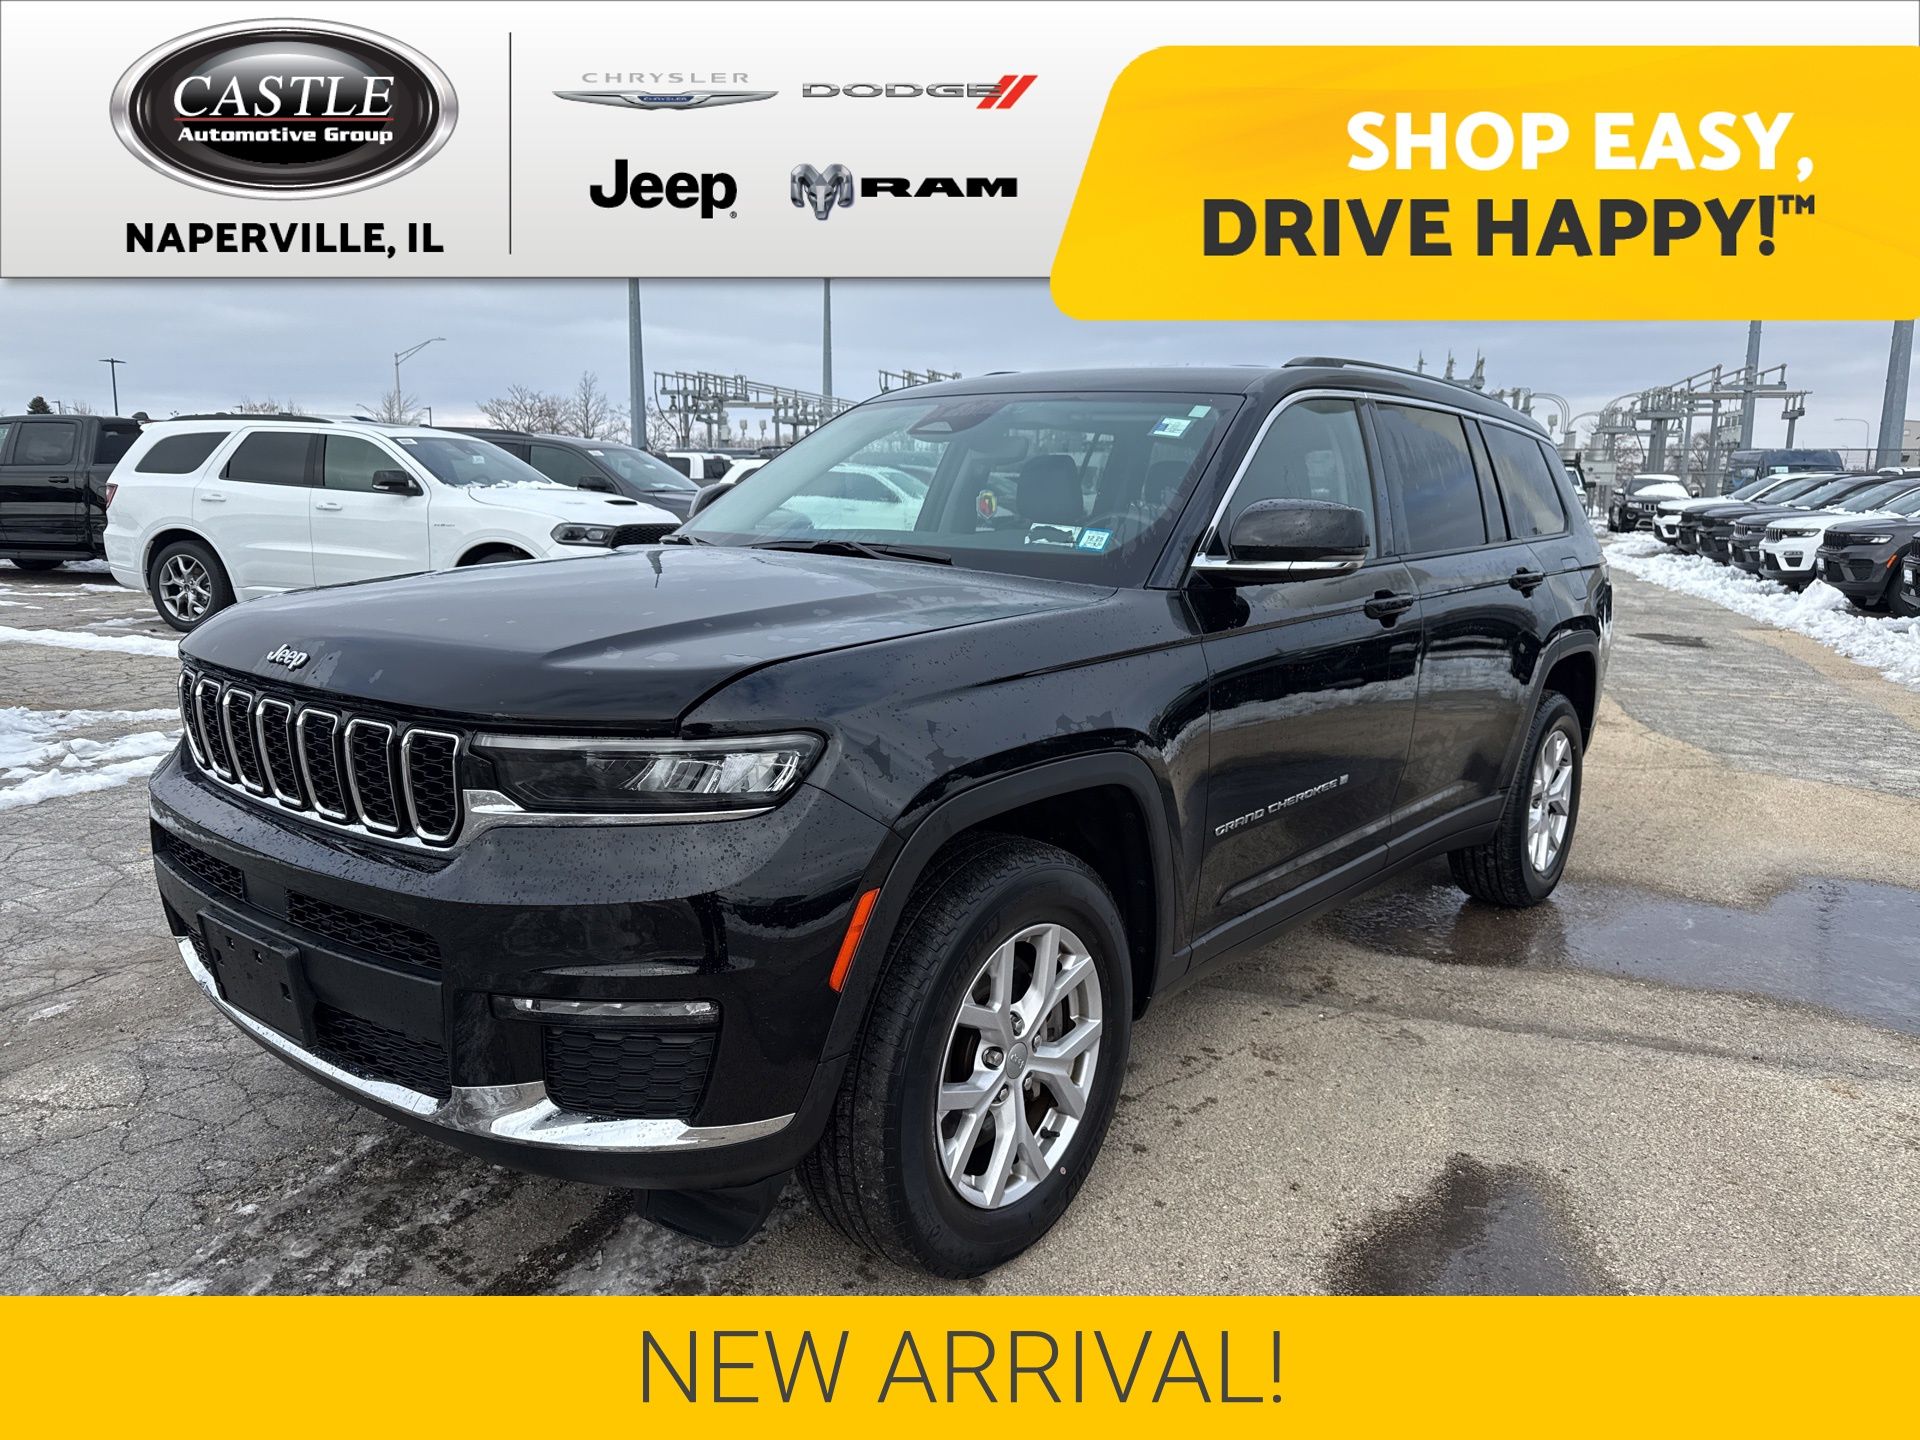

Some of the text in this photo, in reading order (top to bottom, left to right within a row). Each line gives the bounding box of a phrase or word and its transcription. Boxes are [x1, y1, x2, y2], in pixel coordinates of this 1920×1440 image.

[267, 643, 309, 671] Jeep
[1214, 778, 1338, 837] GRAND CHEROKEE
